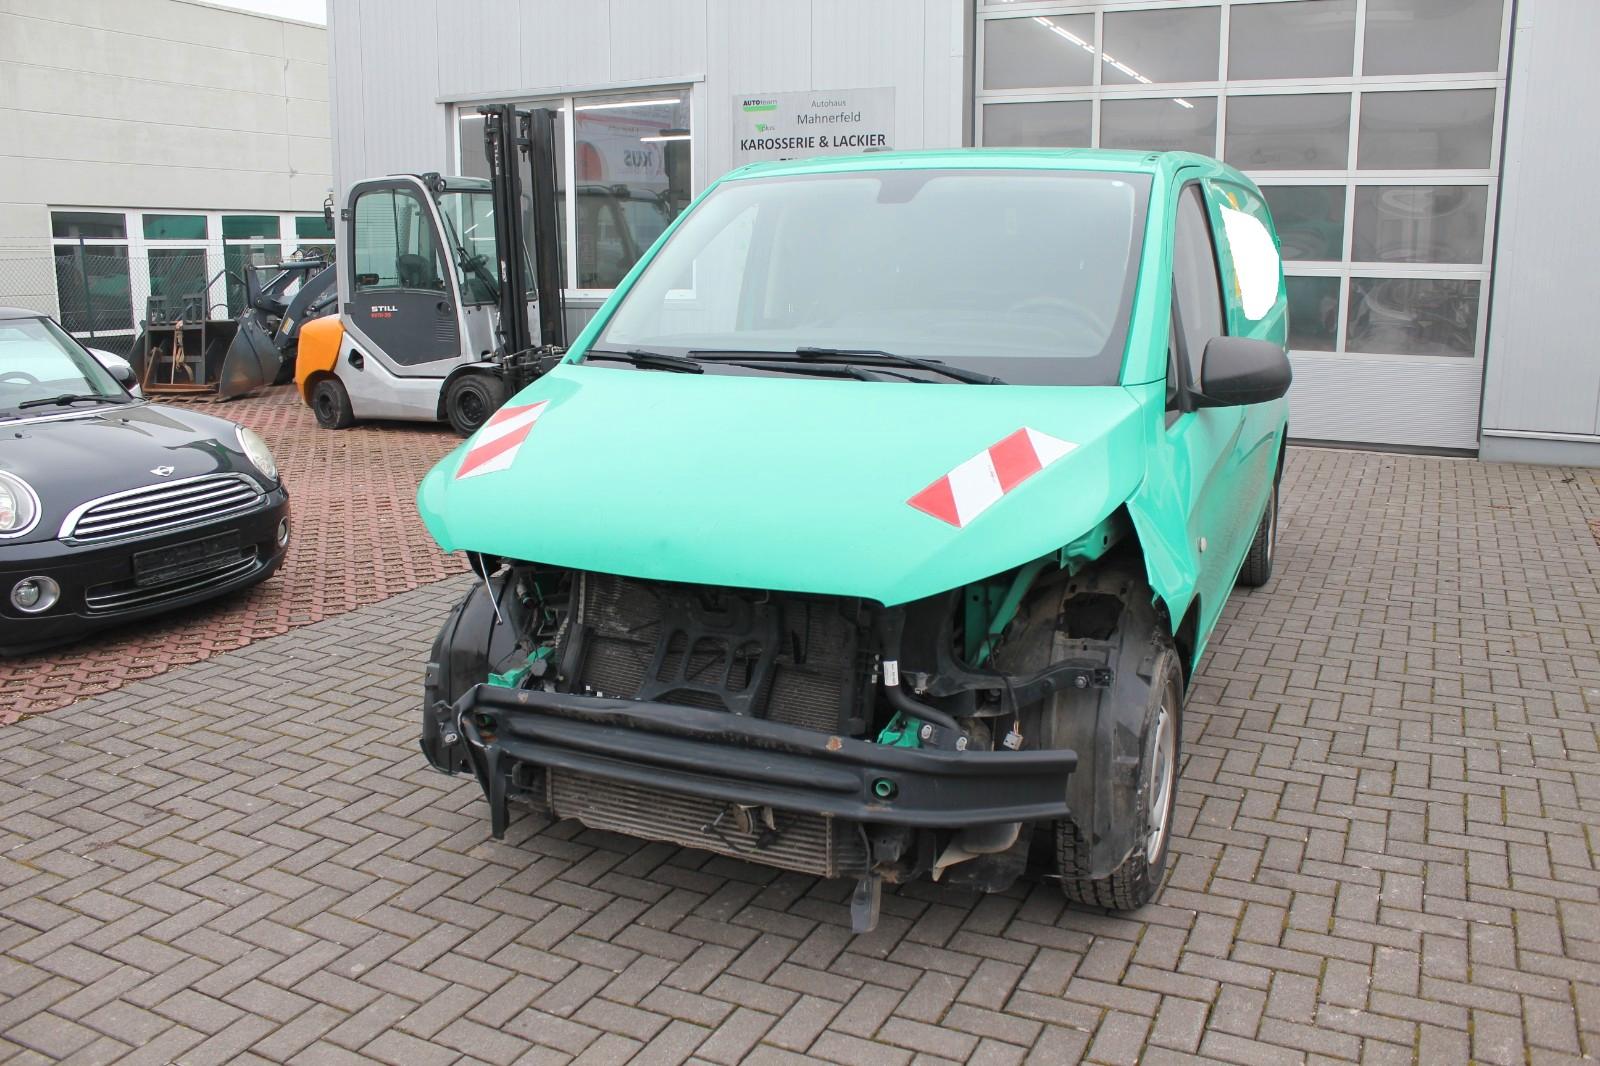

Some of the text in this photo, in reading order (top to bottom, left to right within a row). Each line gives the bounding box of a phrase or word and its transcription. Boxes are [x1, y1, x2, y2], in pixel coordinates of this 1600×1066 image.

[811, 99, 847, 108] Autohaus
[797, 111, 861, 125] Mahnerfeld
[740, 133, 886, 151] KAROSSERIE & LACKIER
